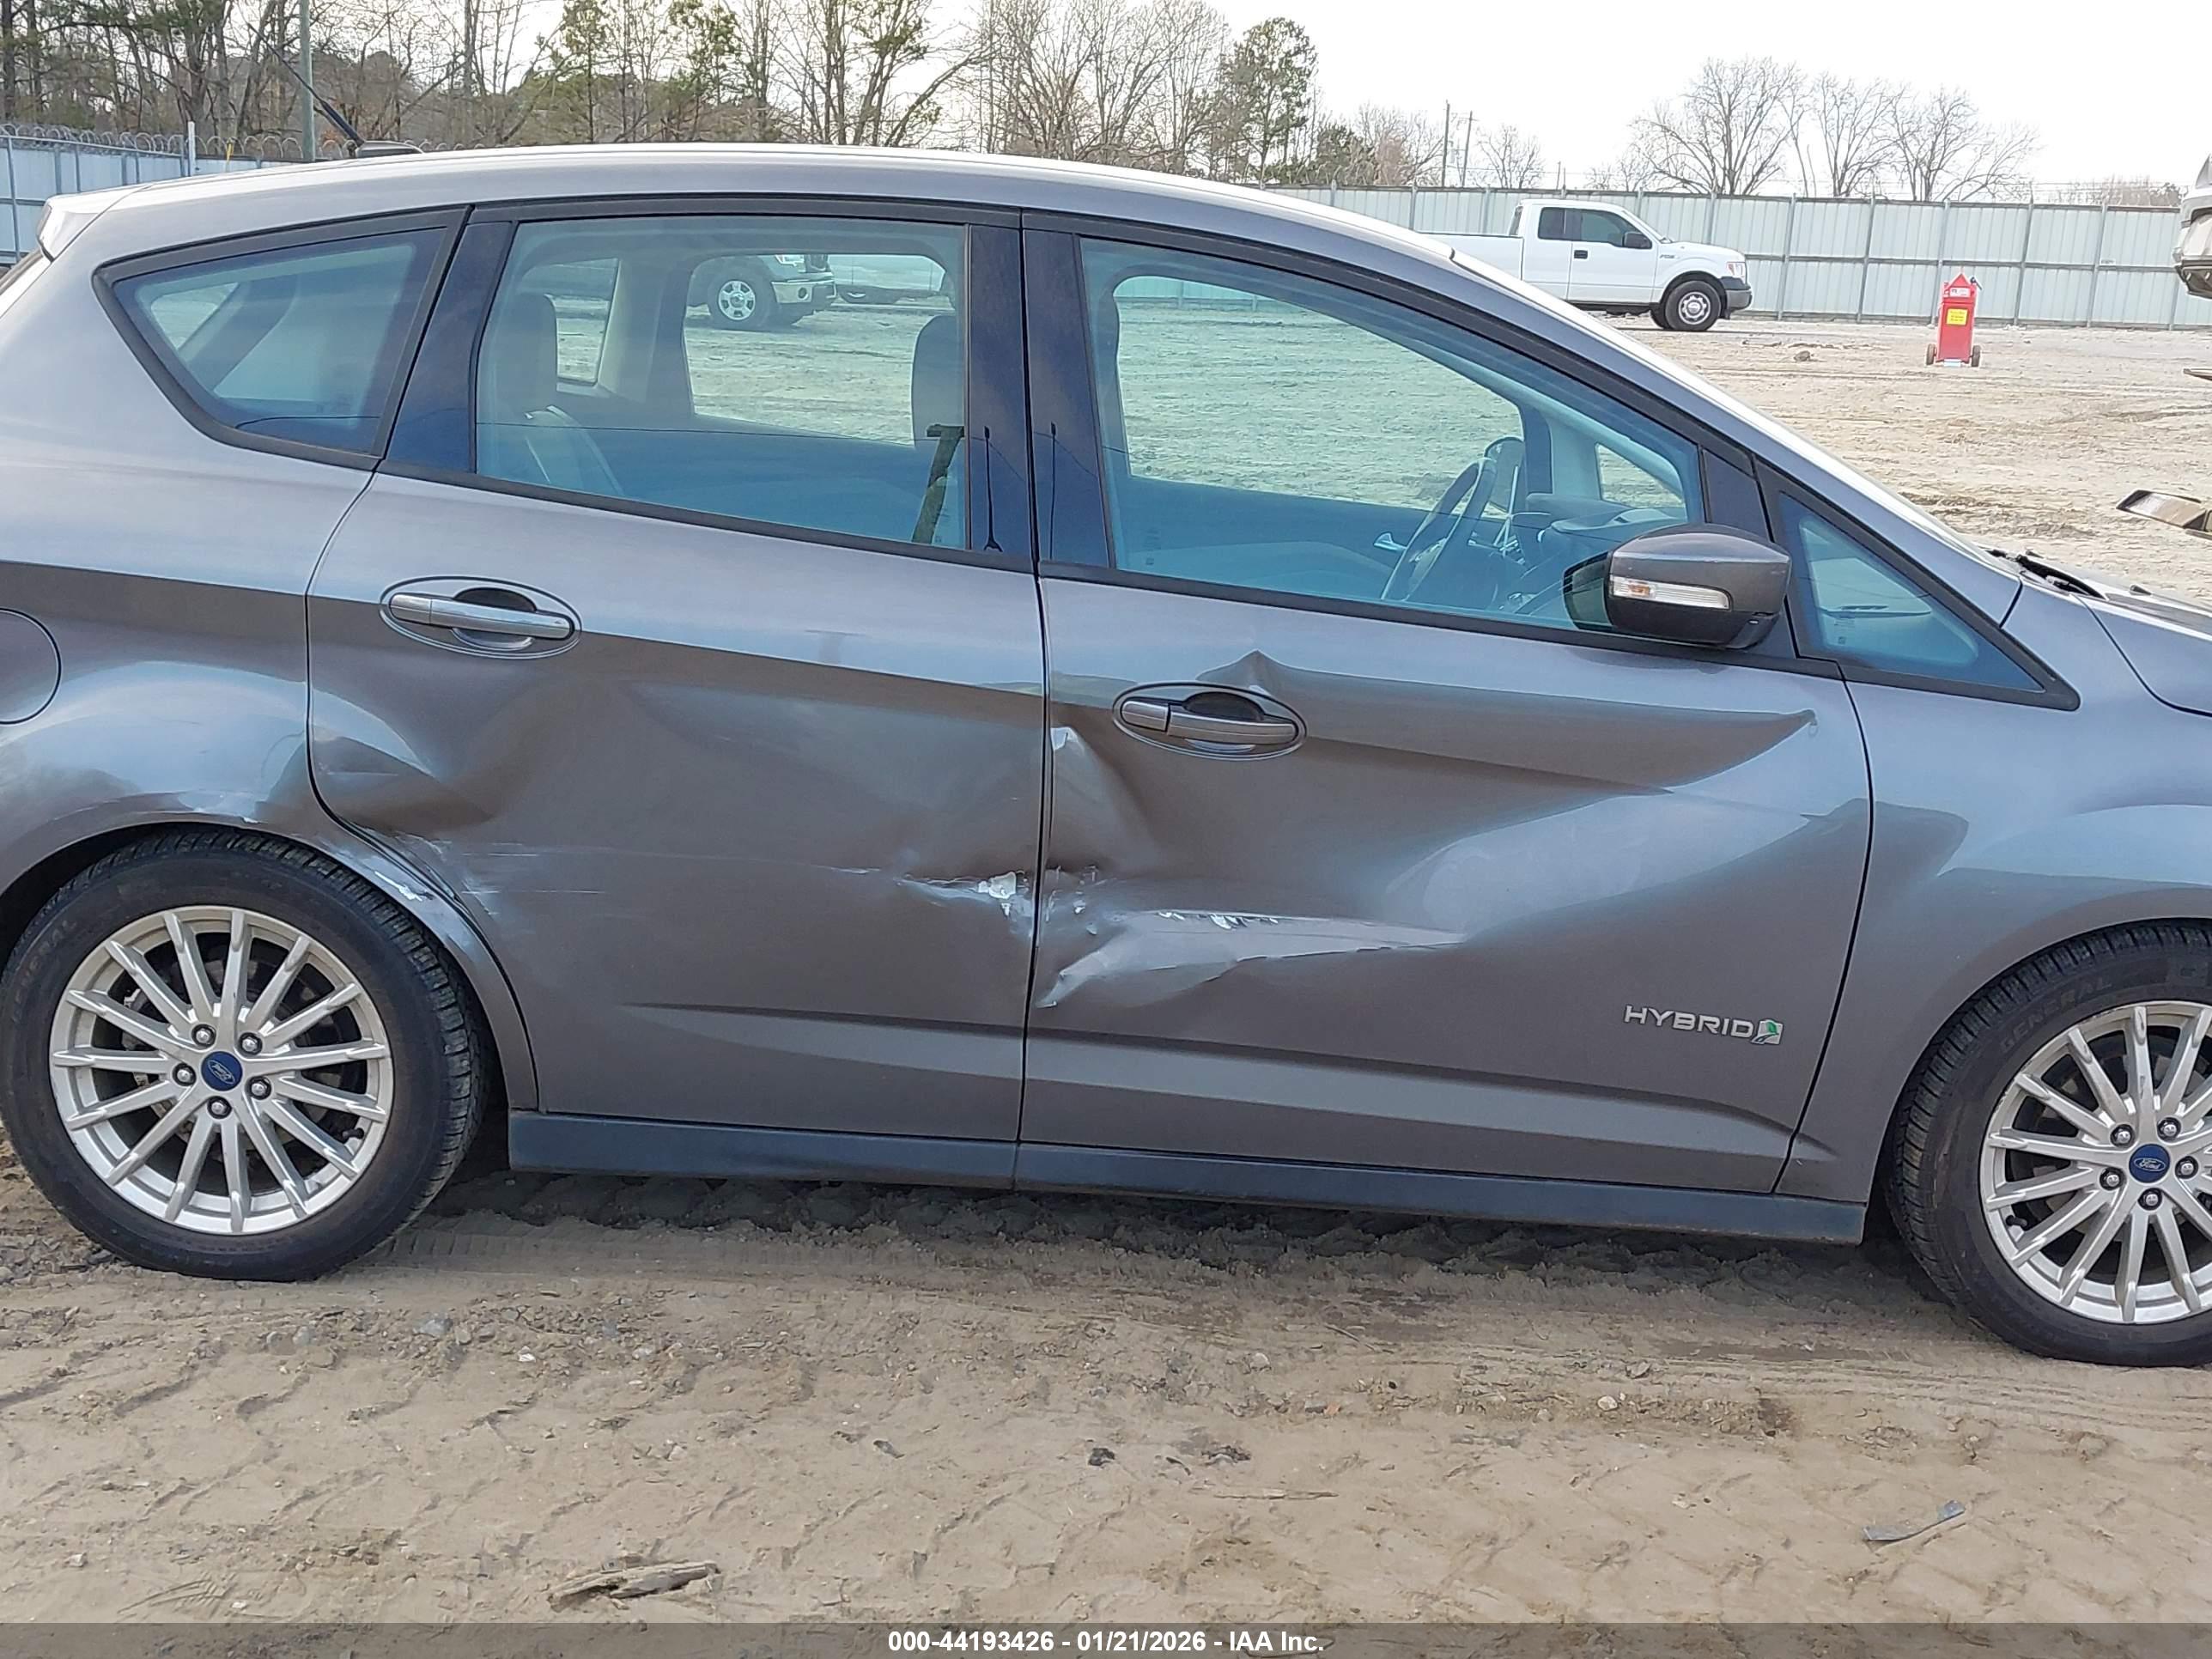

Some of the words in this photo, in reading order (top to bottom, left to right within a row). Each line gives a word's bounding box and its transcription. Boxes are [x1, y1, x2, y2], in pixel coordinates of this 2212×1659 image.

[1624, 1005, 1754, 1038] HYBRID
[1999, 976, 2113, 1054] GENERAL
[2137, 1158, 2162, 1170] Ford
